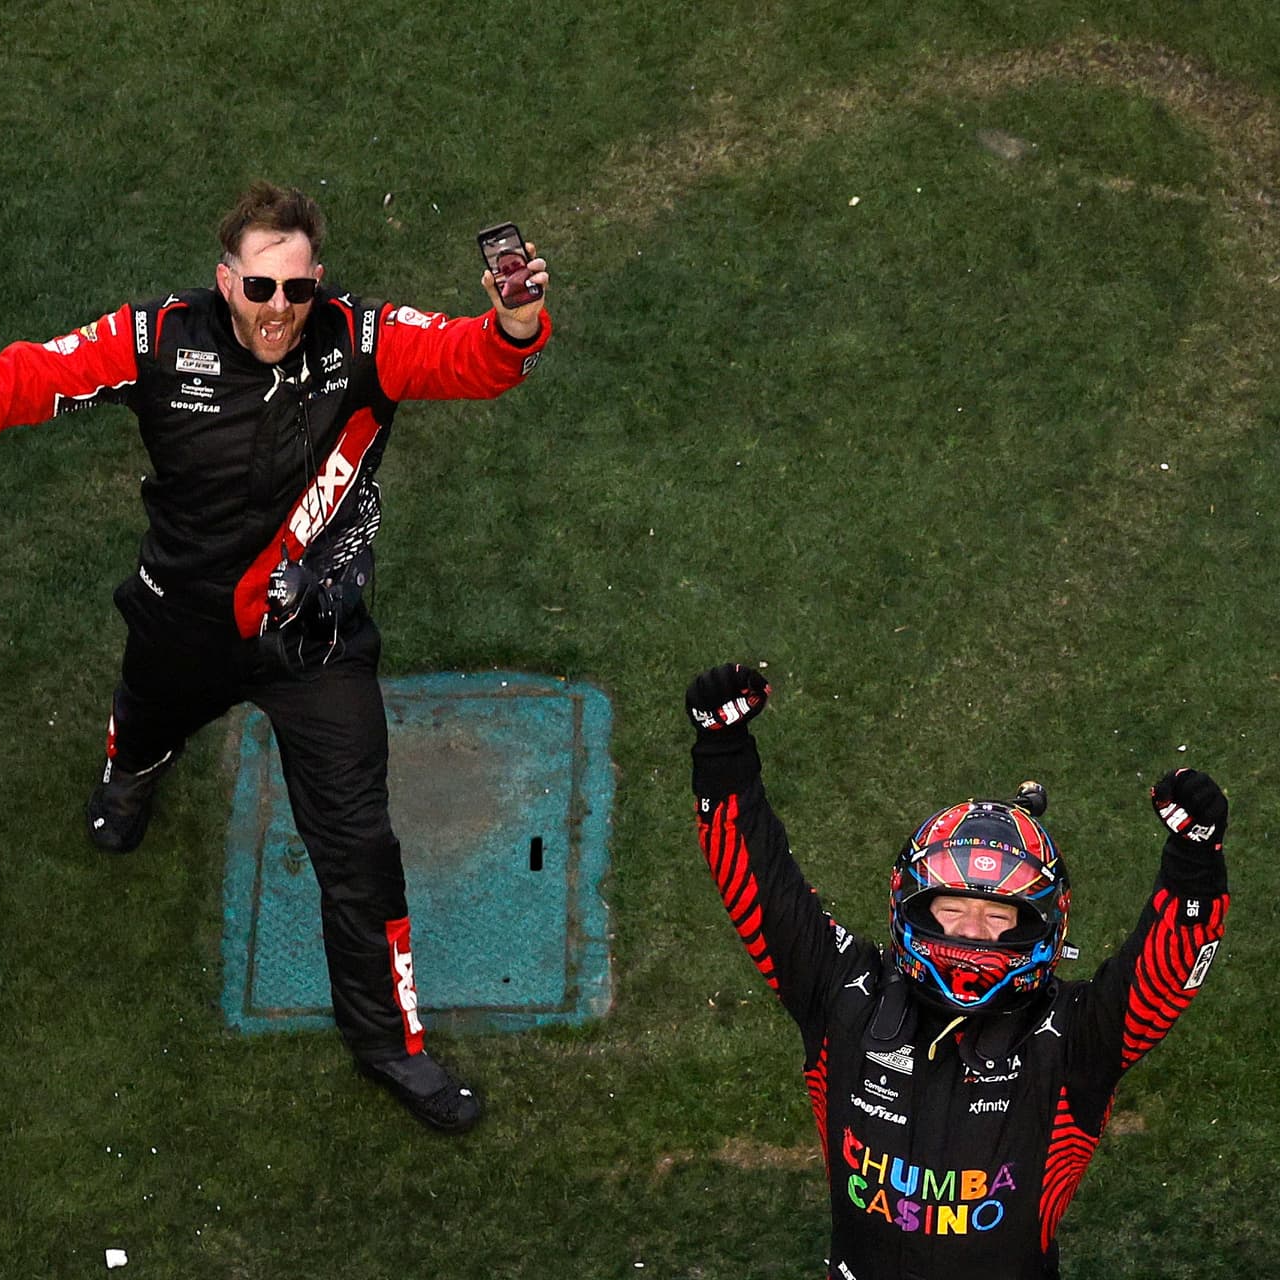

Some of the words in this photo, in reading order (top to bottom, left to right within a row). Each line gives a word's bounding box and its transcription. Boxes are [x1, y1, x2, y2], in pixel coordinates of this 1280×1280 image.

[135, 310, 149, 354] sparco
[361, 308, 376, 354] sparco
[170, 400, 221, 413] GOODYEAR
[942, 838, 987, 849] CHUMBA
[989, 840, 1027, 860] CASINO
[968, 1098, 1011, 1114] xfinity
[842, 1126, 1017, 1202] CHUMBA
[847, 1174, 1005, 1236] CASINO
